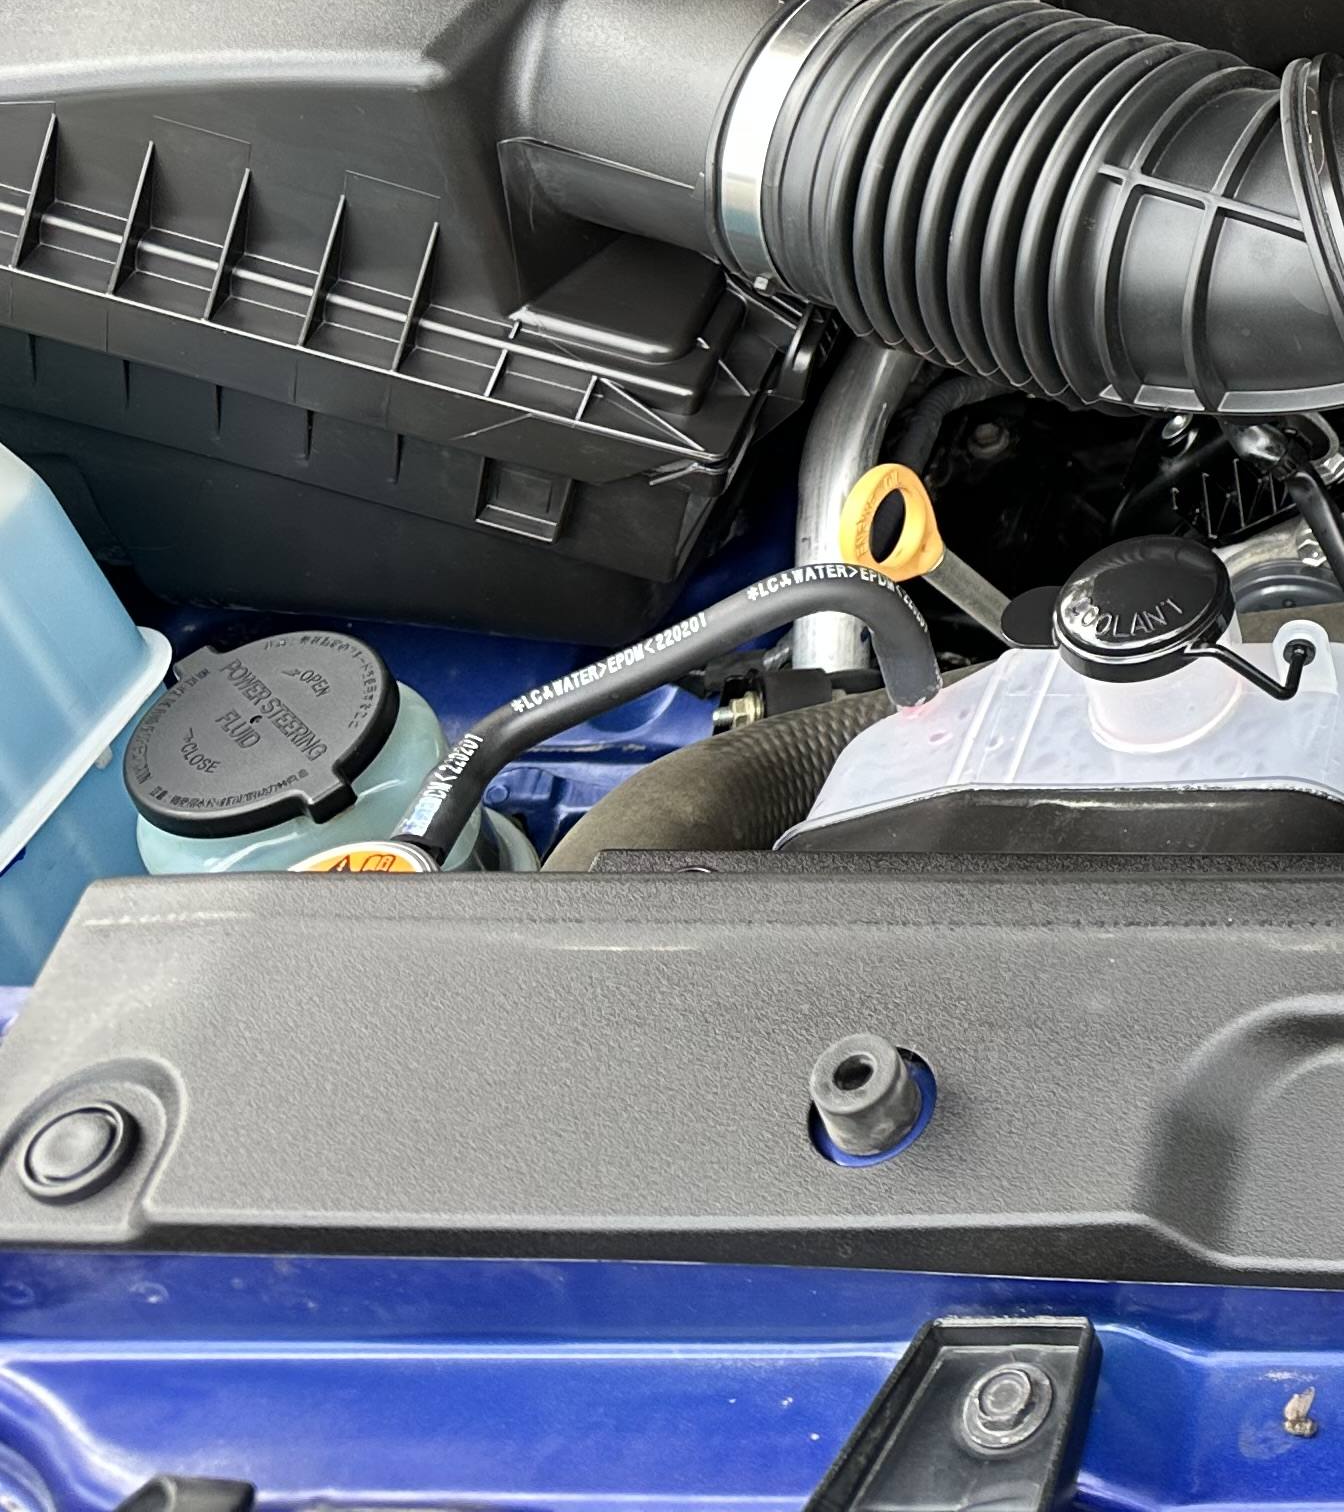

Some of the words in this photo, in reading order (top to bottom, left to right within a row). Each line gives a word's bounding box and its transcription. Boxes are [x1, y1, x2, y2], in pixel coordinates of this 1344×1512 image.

[299, 669, 332, 699] OPEN
[214, 708, 263, 750] FLUID
[220, 658, 272, 706] POWER
[261, 696, 329, 763] STEERING
[179, 741, 222, 775] CLOSE
